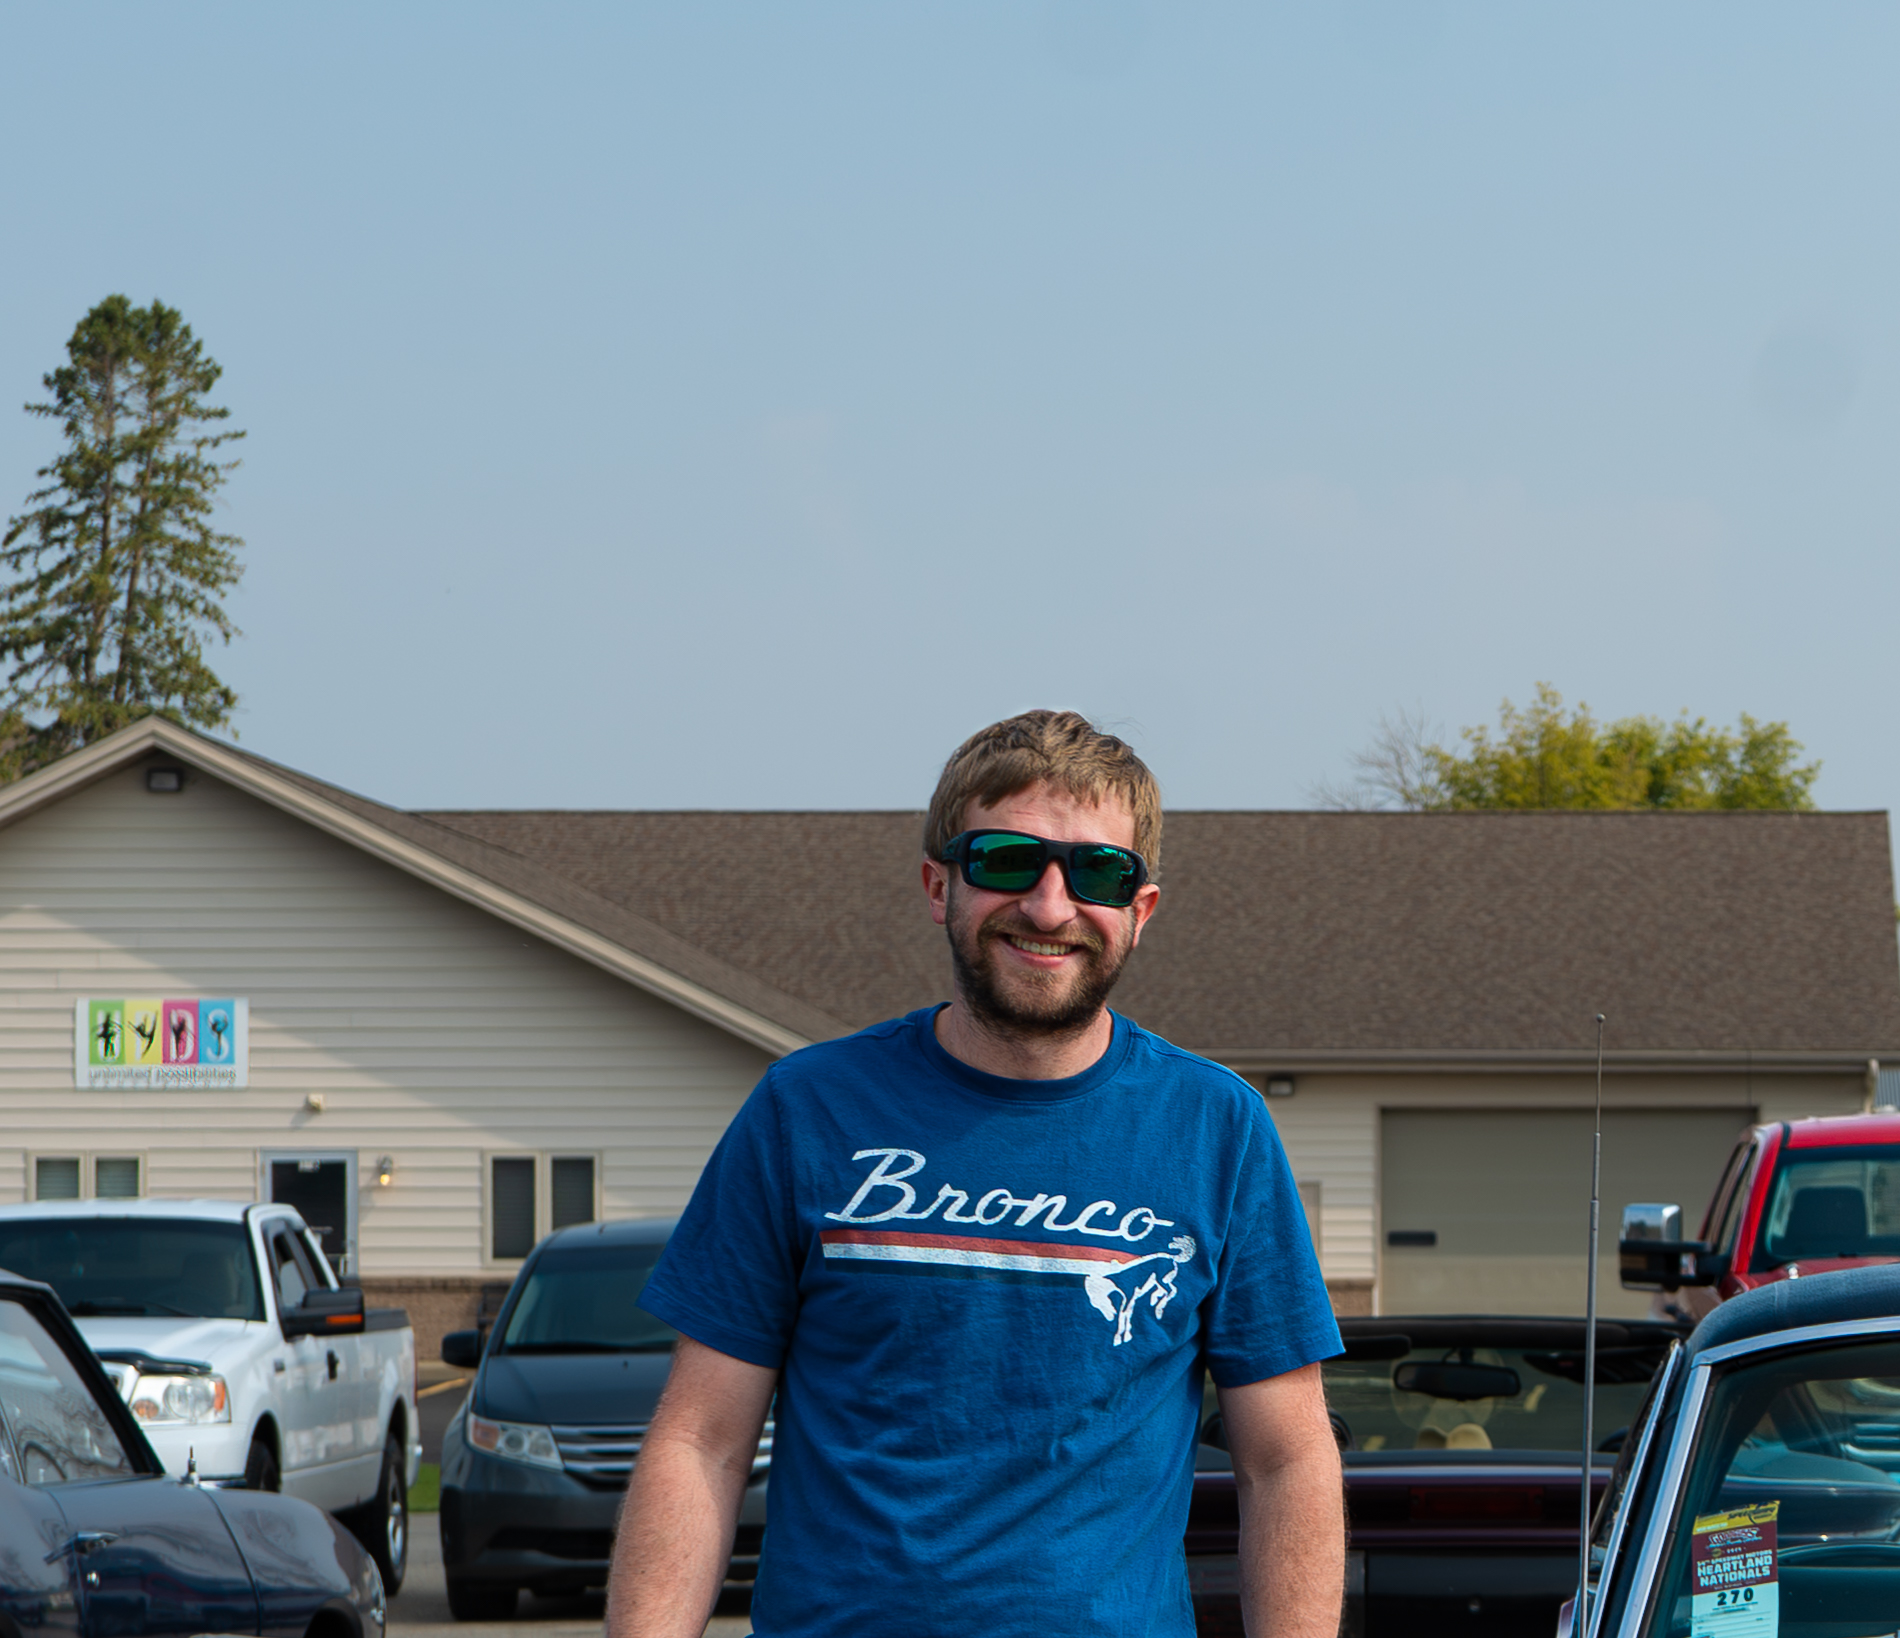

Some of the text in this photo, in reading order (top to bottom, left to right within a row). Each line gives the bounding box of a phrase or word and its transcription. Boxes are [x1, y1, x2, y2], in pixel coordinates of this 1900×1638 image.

[824, 1147, 1175, 1243] Bronco
[1697, 1555, 1773, 1577] HEARTLAND
[1700, 1565, 1771, 1587] NATIONALS
[1716, 1587, 1754, 1606] 270
